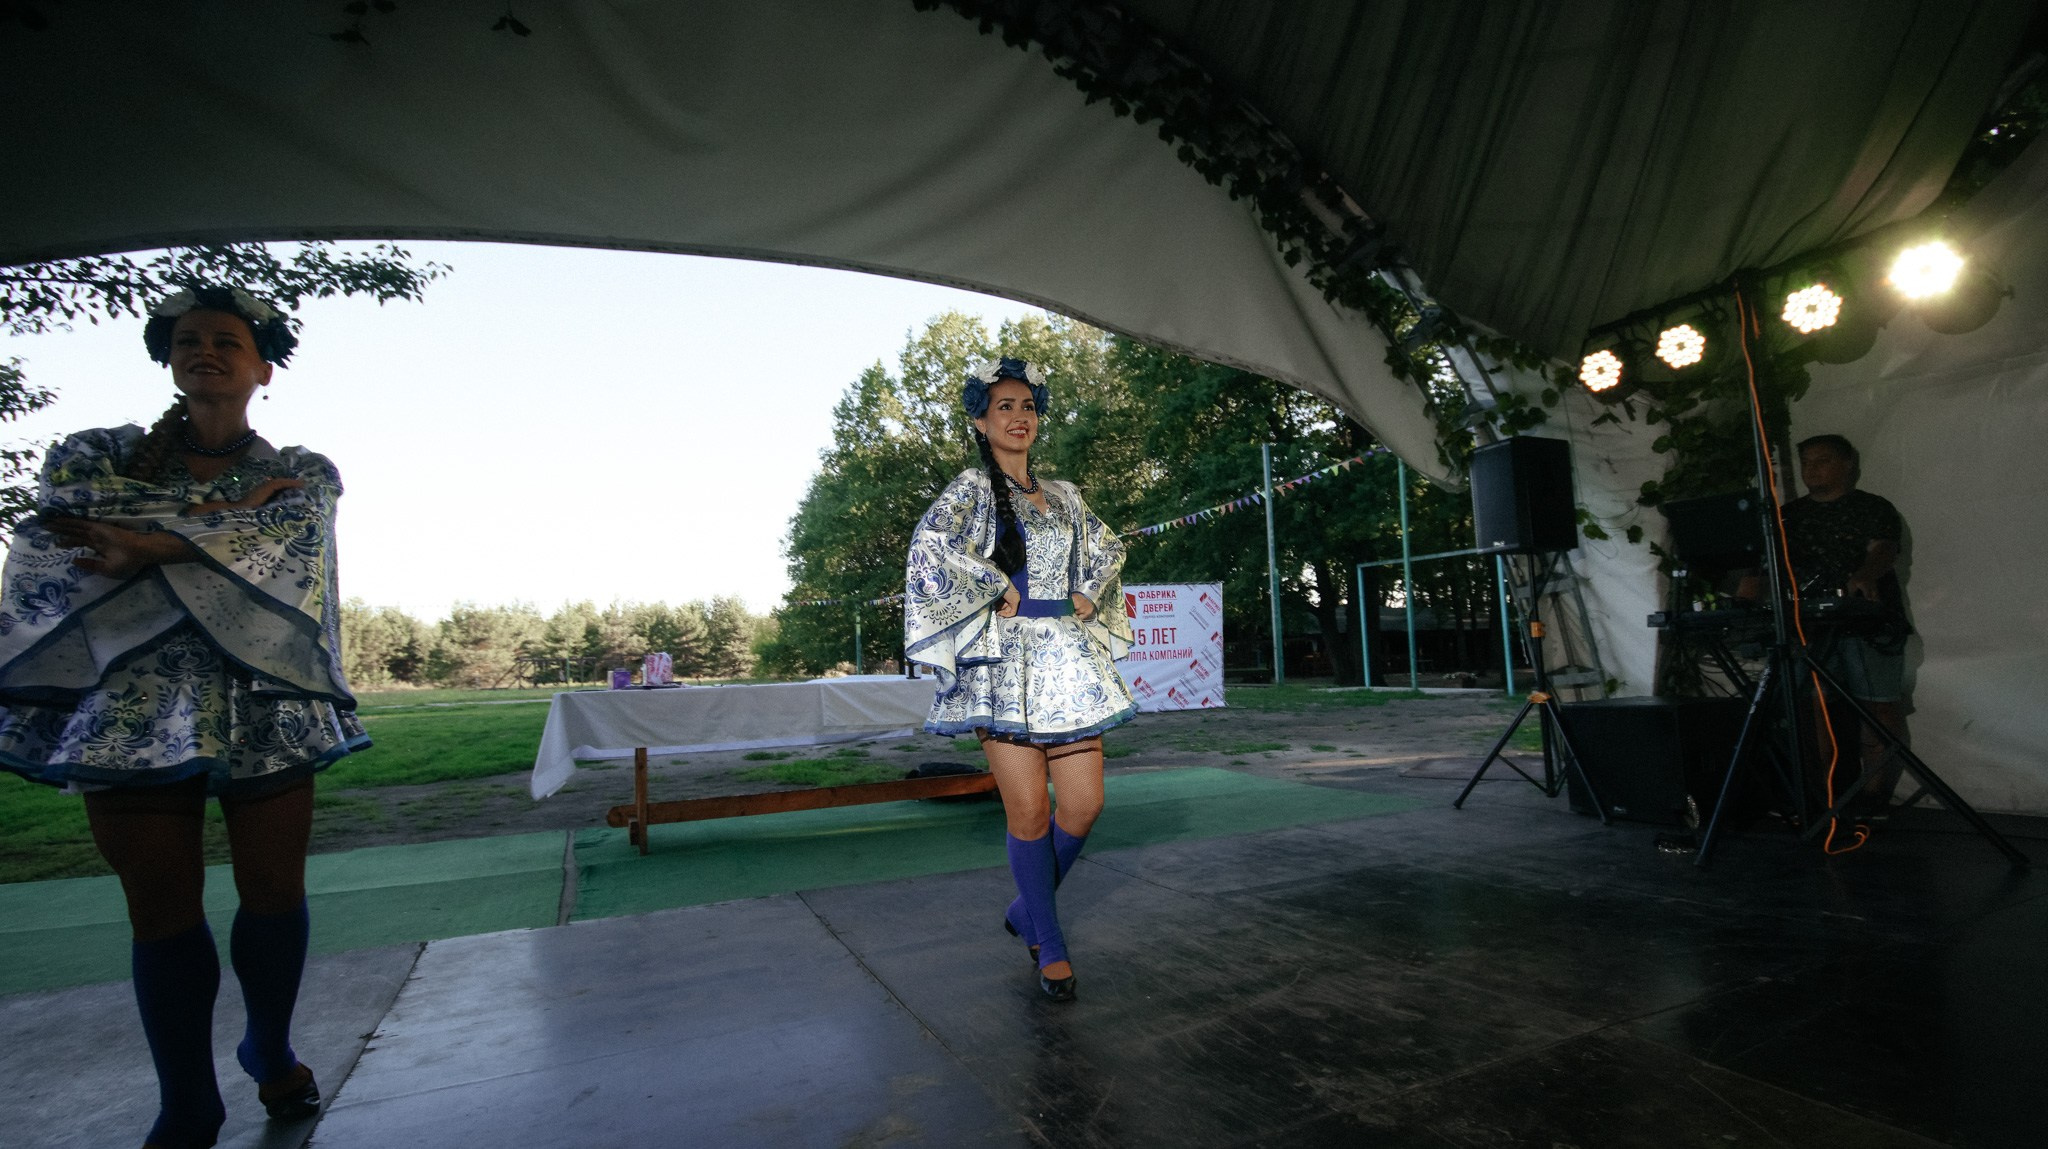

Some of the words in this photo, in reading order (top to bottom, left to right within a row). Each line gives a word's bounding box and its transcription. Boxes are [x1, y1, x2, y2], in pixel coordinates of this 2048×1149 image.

[1138, 590, 1177, 599] ФАБРИКА
[1143, 602, 1174, 614] ДВЕРЕЙ
[1151, 628, 1177, 645] ЛЕТ
[1149, 646, 1193, 661] КОМПАНИЙ
